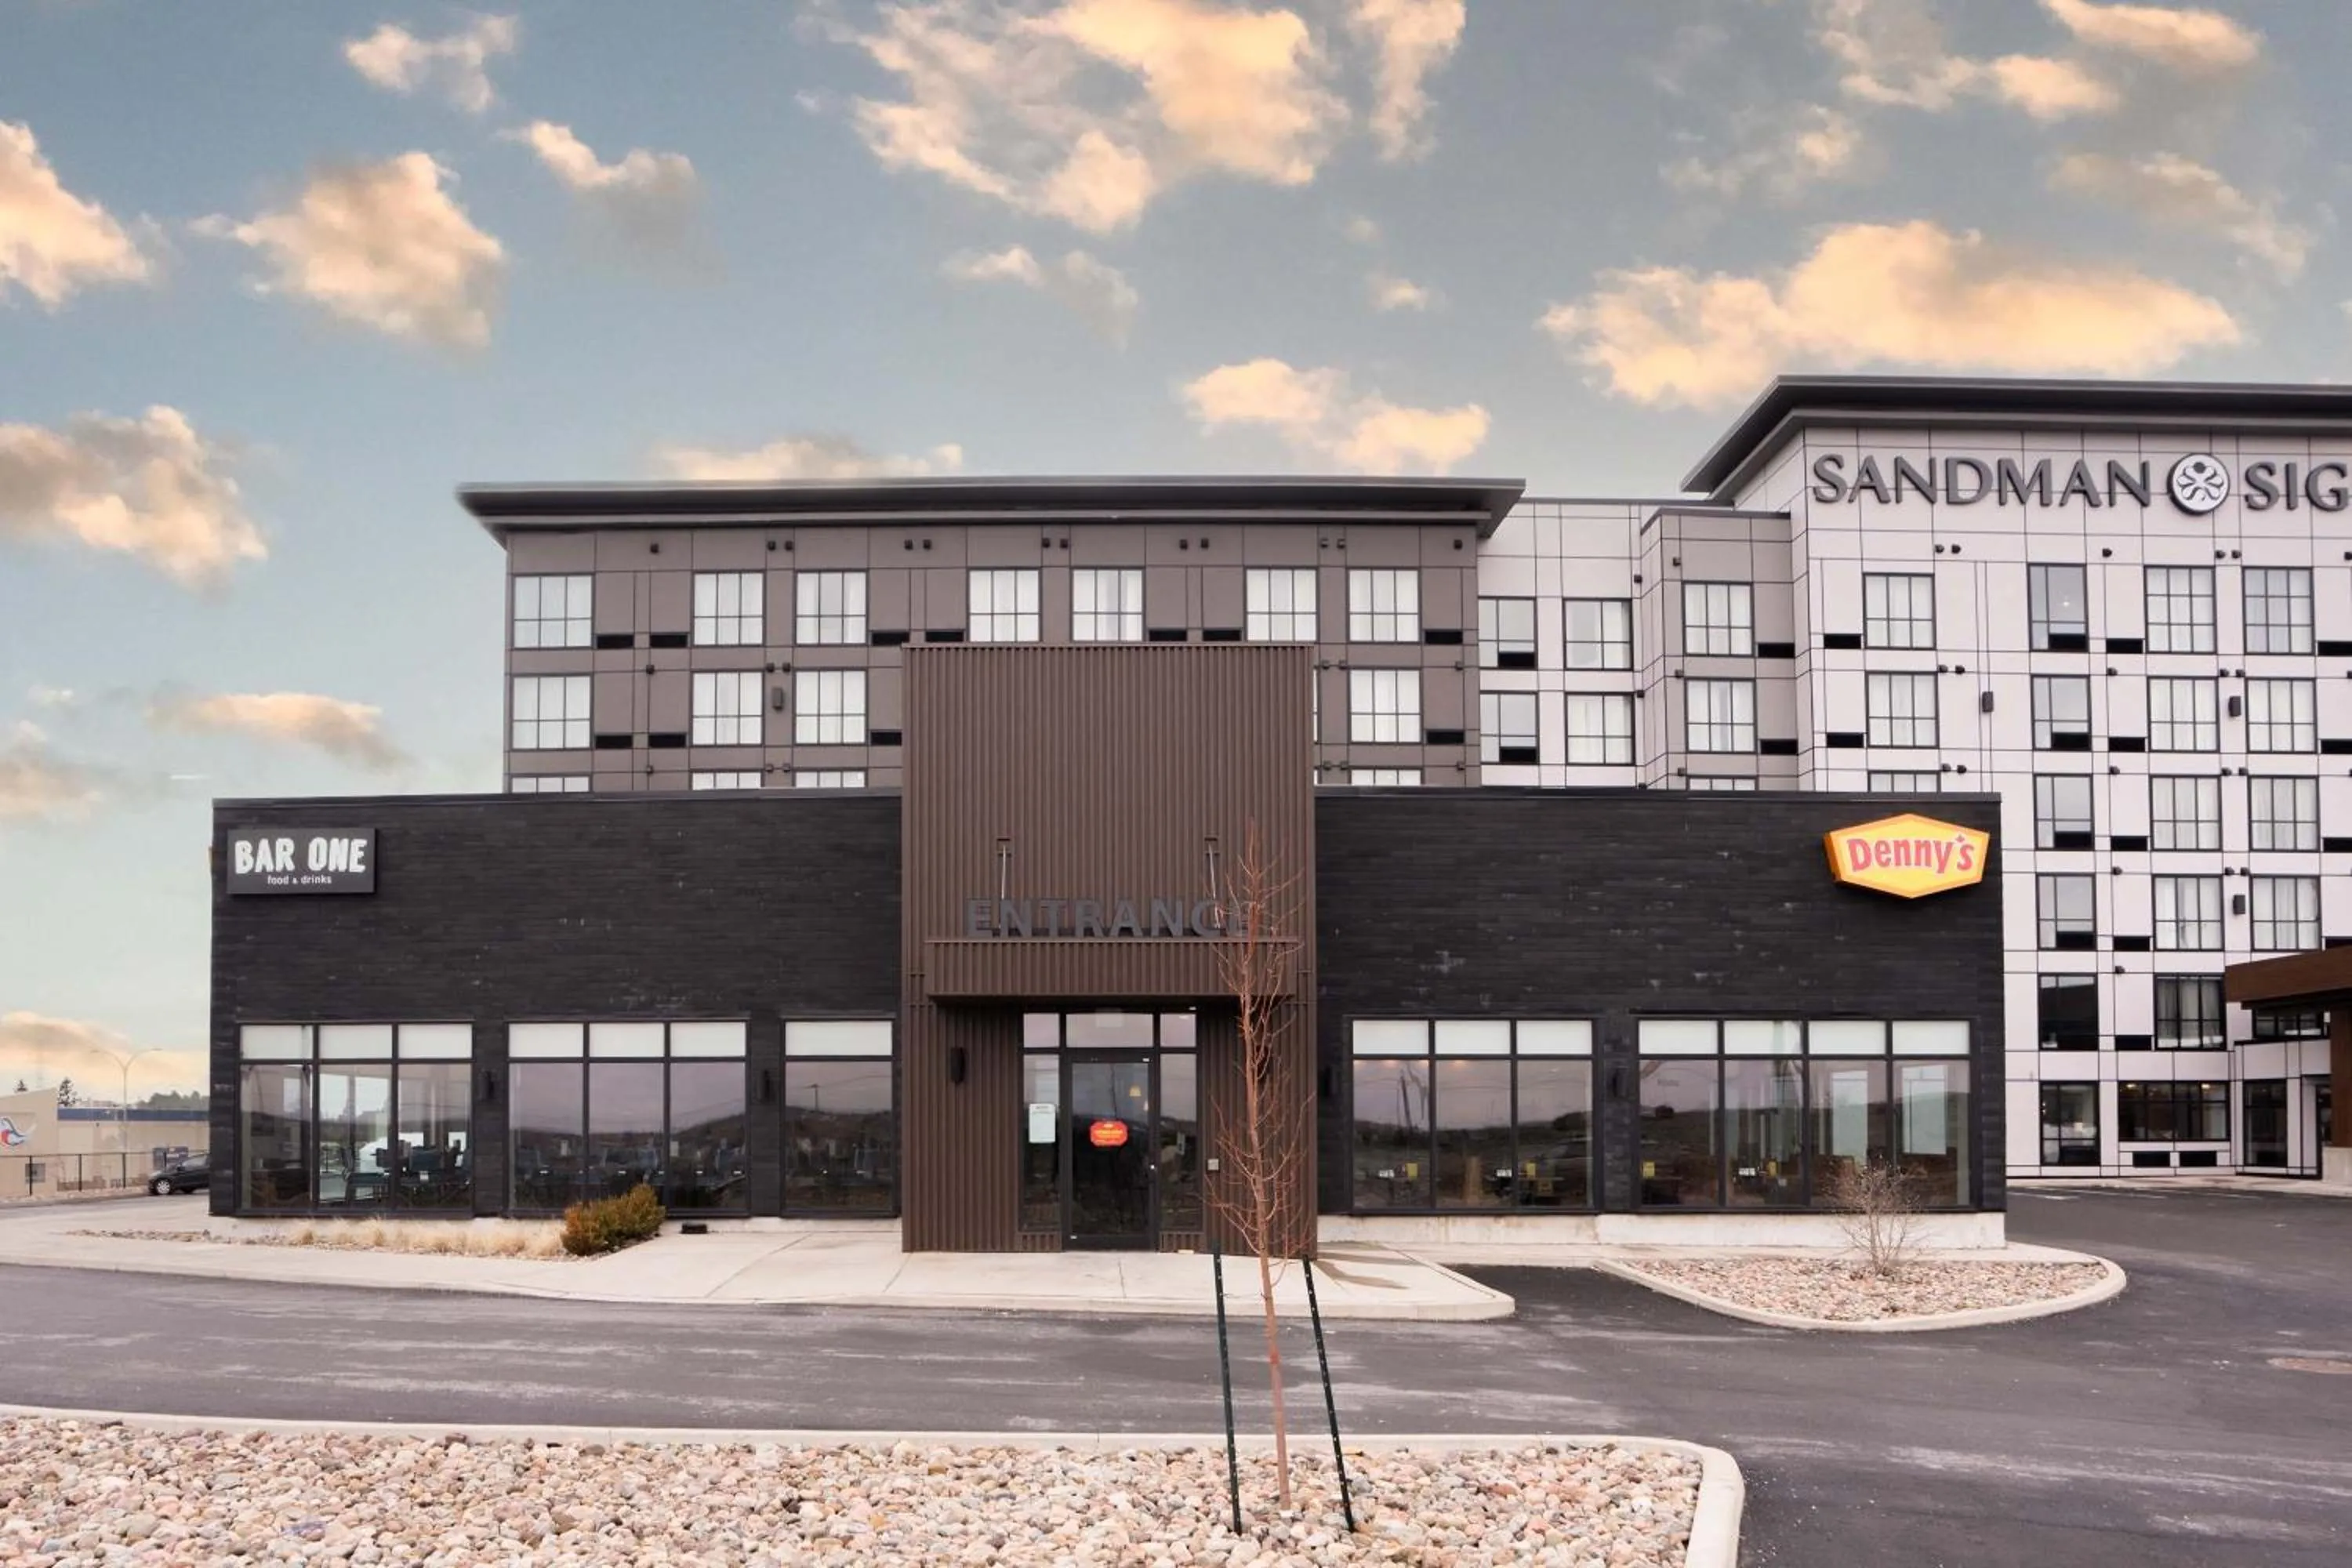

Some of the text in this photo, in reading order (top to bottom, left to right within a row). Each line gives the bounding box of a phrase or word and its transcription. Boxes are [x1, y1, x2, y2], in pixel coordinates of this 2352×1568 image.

[1813, 453, 2350, 513] SANDMAN SIG
[235, 837, 368, 874] BAR ONE
[1846, 833, 1975, 874] Denny's
[267, 874, 289, 885] food
[301, 874, 332, 885] drinks
